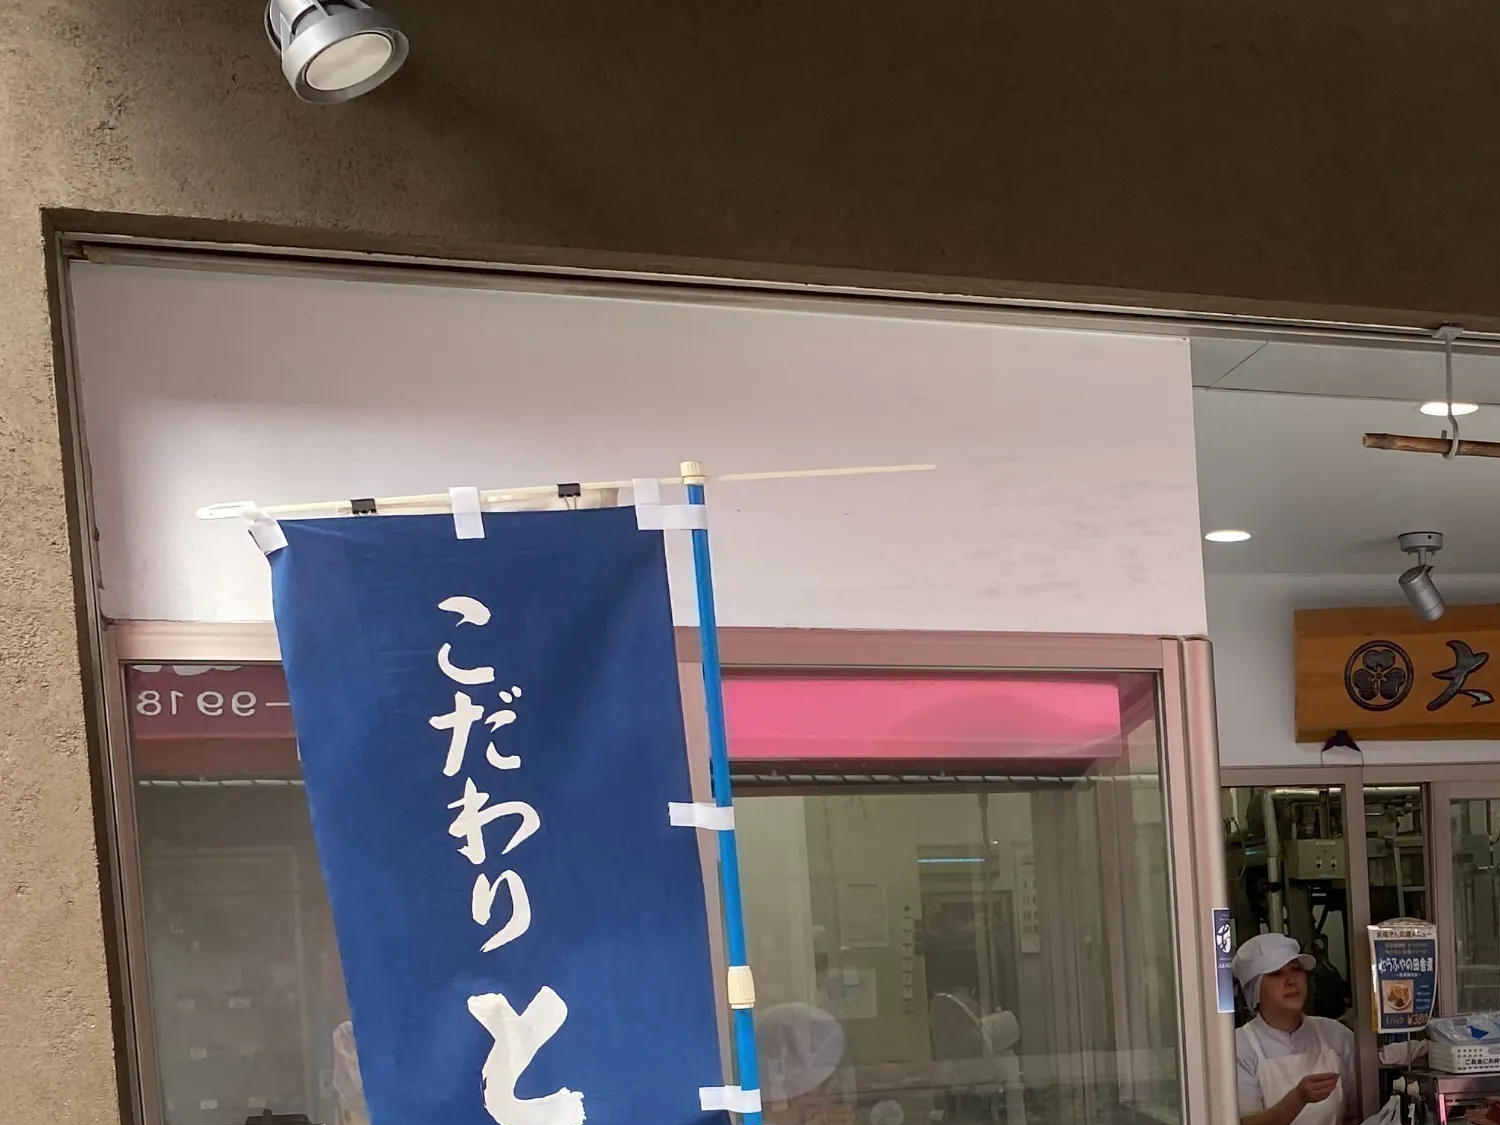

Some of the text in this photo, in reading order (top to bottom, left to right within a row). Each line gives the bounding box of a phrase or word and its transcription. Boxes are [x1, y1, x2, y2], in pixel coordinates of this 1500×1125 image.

[429, 595, 540, 954] こだわり
[1378, 957, 1434, 974] とうふやの田舎煮
